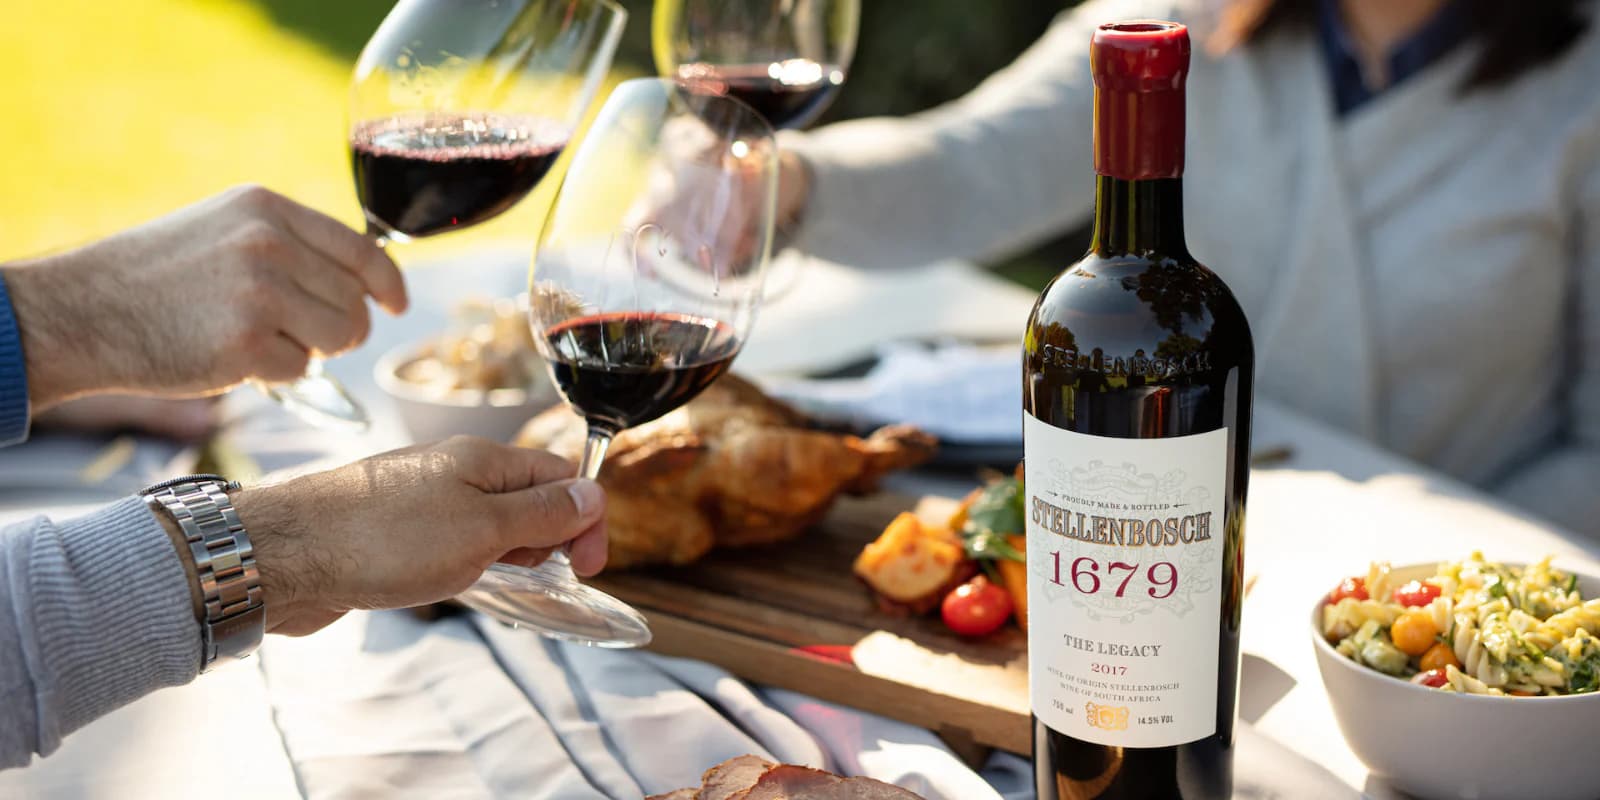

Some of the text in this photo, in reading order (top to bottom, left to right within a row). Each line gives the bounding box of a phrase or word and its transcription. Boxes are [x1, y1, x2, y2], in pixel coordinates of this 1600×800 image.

[1062, 494, 1096, 507] PROUDLY
[1098, 502, 1120, 510] MADE
[1131, 503, 1170, 511] BOTTLED
[1032, 496, 1212, 547] STELLENBOSCH
[1049, 550, 1179, 599] 1679
[1063, 634, 1162, 657] THE LEGACY
[1091, 663, 1128, 676] 2017
[1060, 682, 1080, 694] WINE
[1081, 689, 1092, 697] OF
[1094, 692, 1124, 702] SOUTH
[1065, 673, 1075, 682] OF
[1077, 678, 1108, 689] ORIGIN
[1110, 682, 1180, 692] STELLENBOSCH
[1160, 714, 1174, 724] VOL
